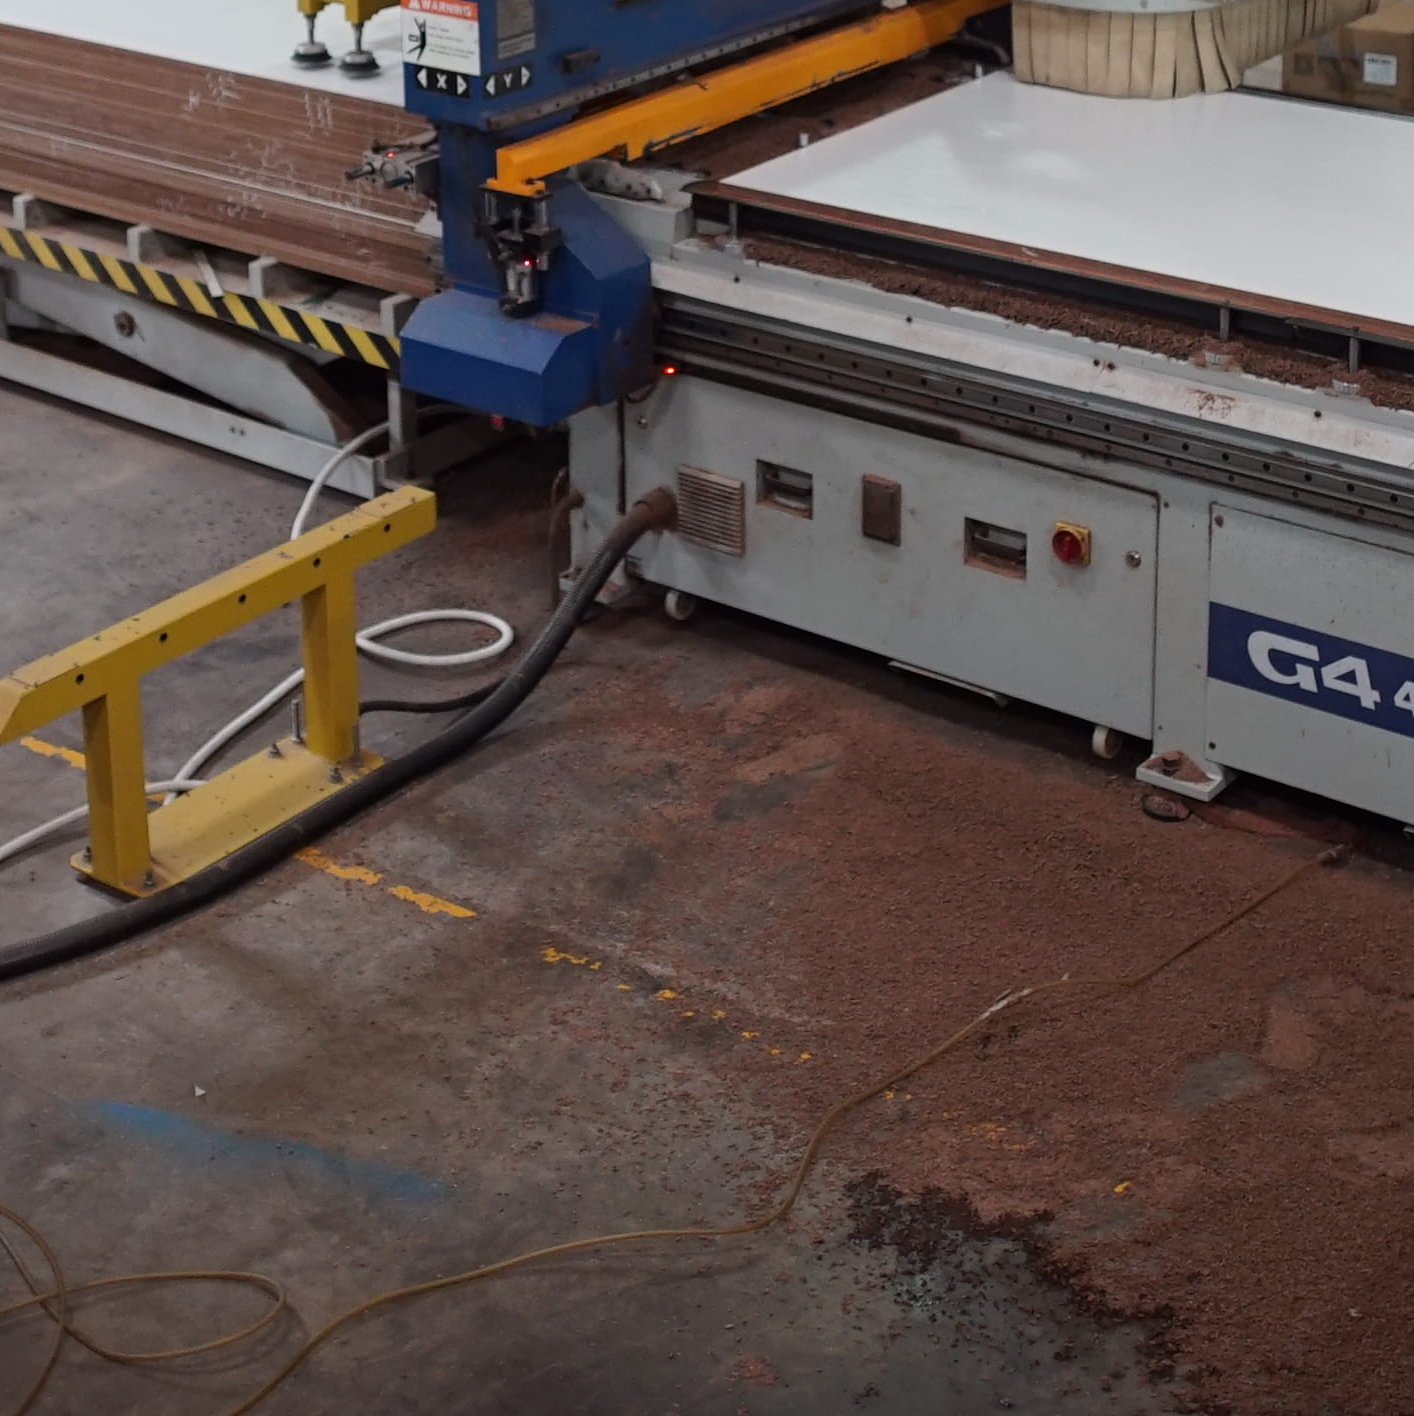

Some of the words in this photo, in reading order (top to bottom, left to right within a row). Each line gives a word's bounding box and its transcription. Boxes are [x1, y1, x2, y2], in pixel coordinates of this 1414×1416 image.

[436, 73, 447, 90] X
[503, 73, 513, 89] Y
[1247, 630, 1382, 711] G4
